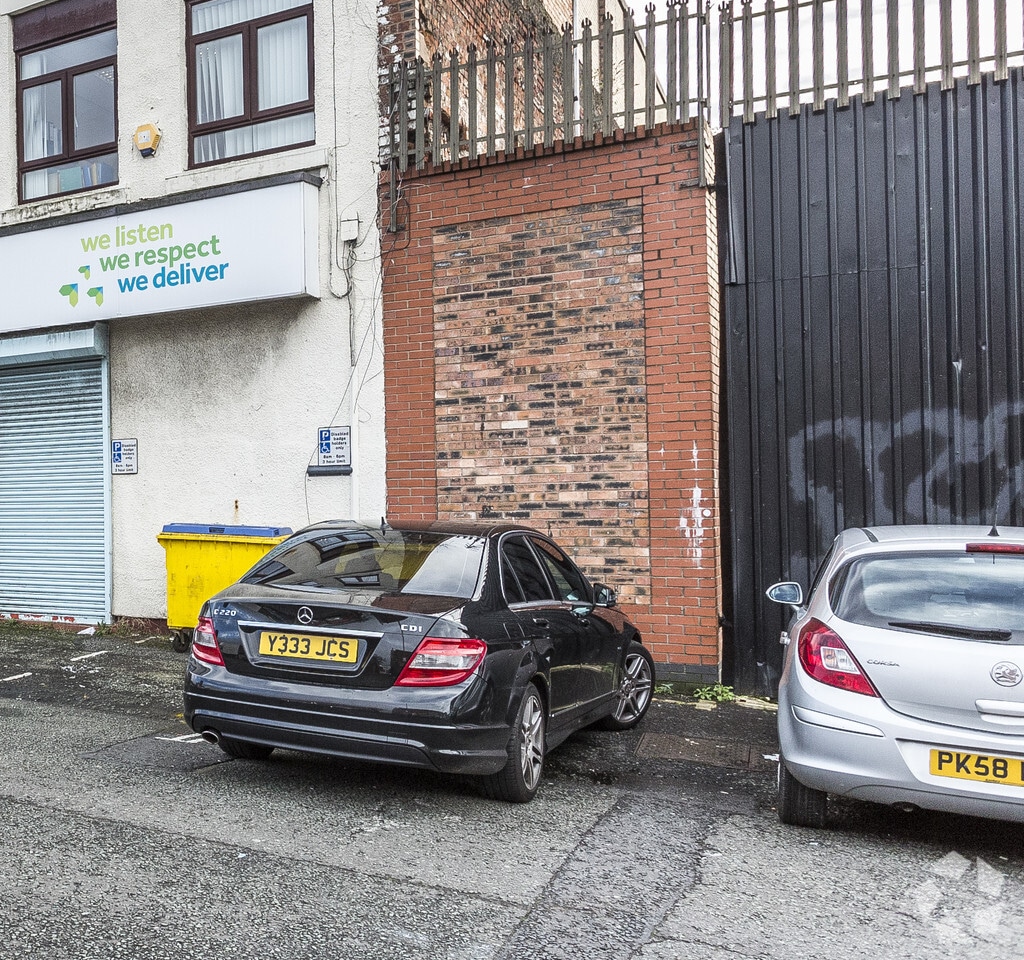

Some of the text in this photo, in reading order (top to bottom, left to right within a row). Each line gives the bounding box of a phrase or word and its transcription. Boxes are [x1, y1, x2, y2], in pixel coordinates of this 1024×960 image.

[81, 222, 174, 252] we listen
[99, 235, 222, 272] we respect
[117, 262, 229, 293] we deliver
[401, 624, 423, 633] CDI
[268, 634, 350, 659] Y333 JCS
[937, 751, 1009, 779] PK58
